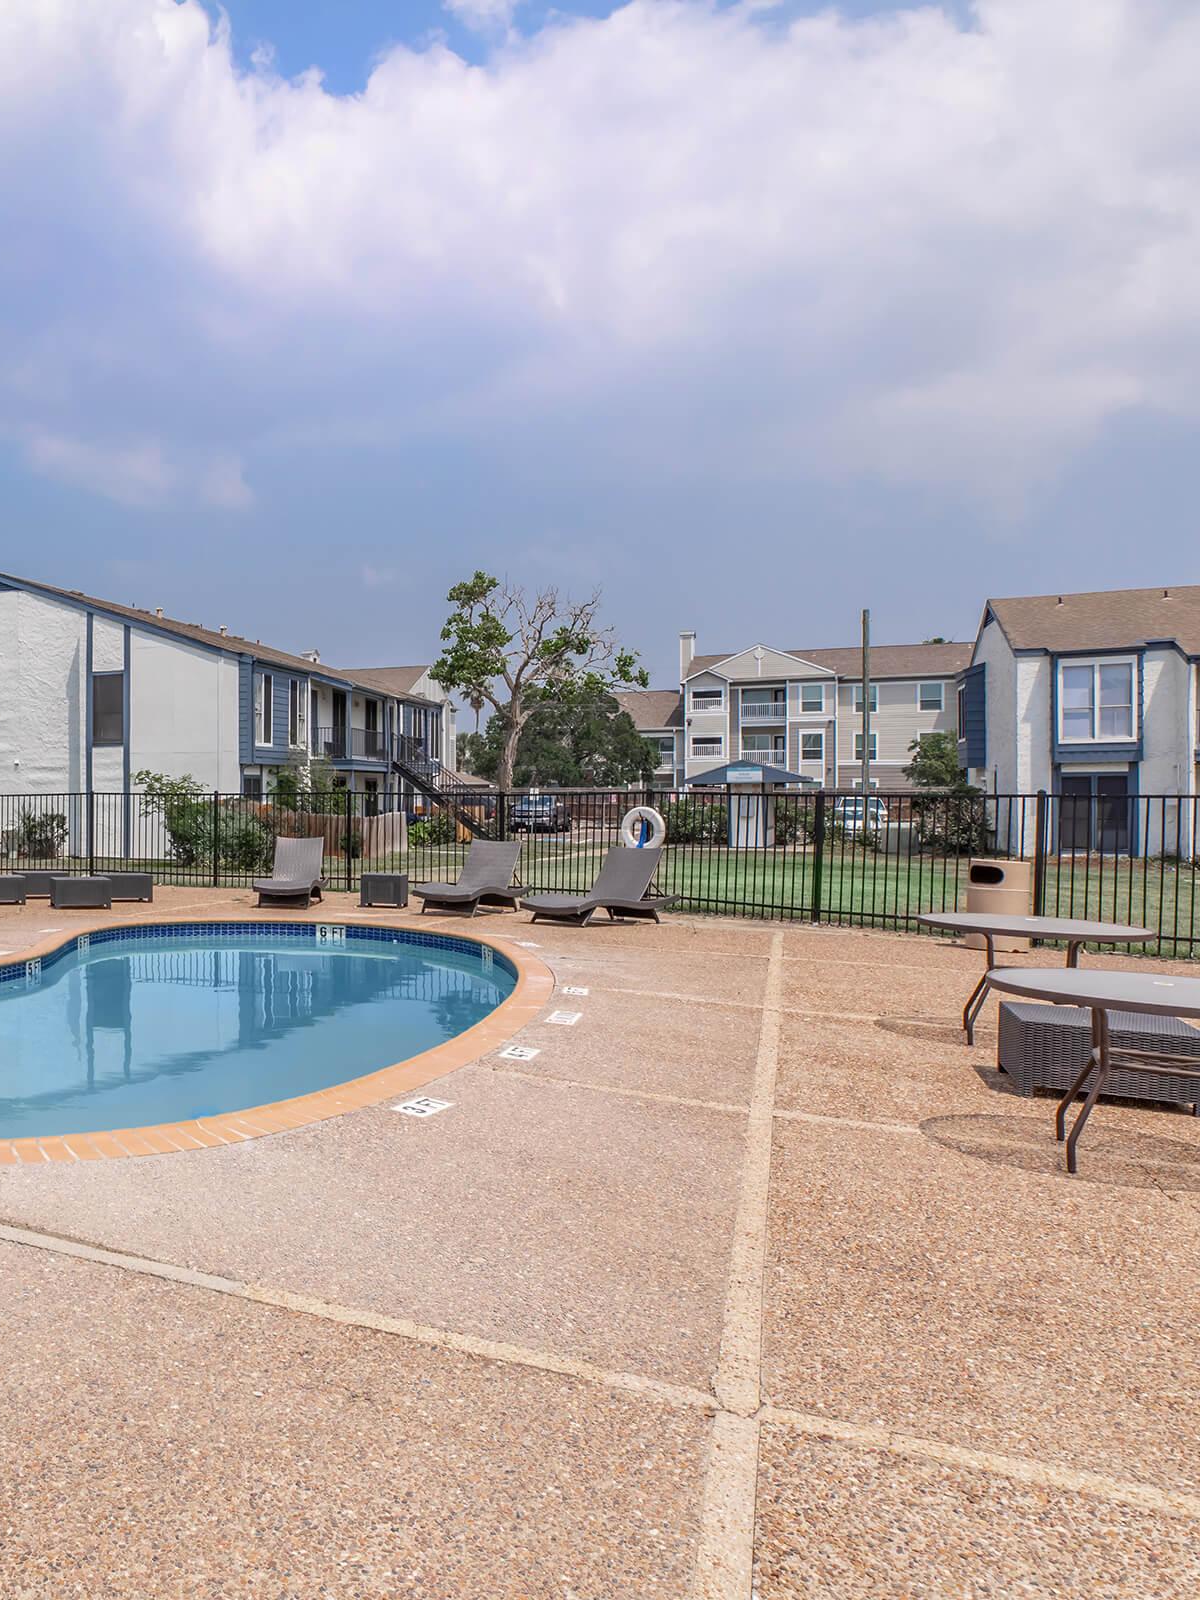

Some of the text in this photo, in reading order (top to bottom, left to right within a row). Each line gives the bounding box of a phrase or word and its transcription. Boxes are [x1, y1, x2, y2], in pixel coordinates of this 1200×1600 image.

[320, 926, 344, 938] 6 FT
[402, 1098, 446, 1113] 3 FT
